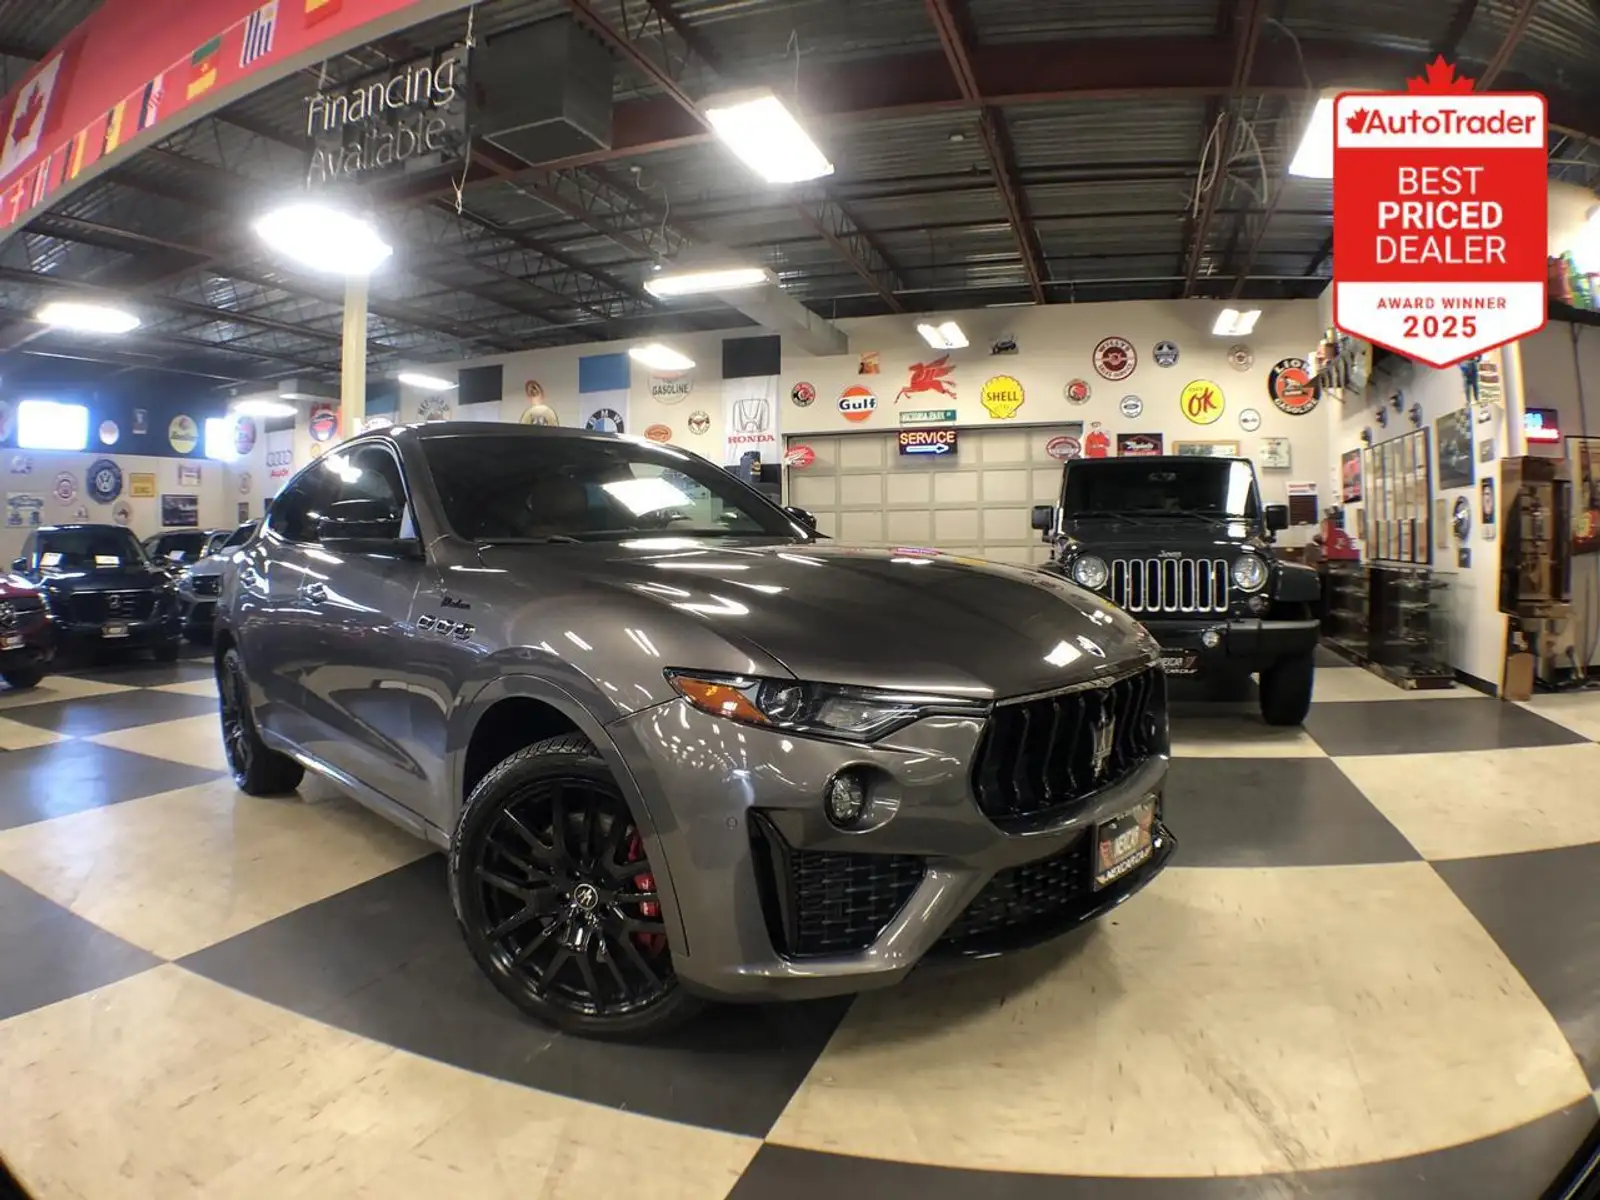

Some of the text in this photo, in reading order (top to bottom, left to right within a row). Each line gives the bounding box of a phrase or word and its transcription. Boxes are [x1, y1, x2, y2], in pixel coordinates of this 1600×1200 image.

[304, 57, 455, 136] Financing
[306, 112, 446, 190] Available
[652, 382, 689, 396] GASOLINE
[986, 391, 1019, 402] SHELL
[1188, 386, 1217, 417] OK
[839, 398, 876, 410] Gulf
[728, 434, 775, 444] HONDA
[899, 431, 956, 444] SERVICE
